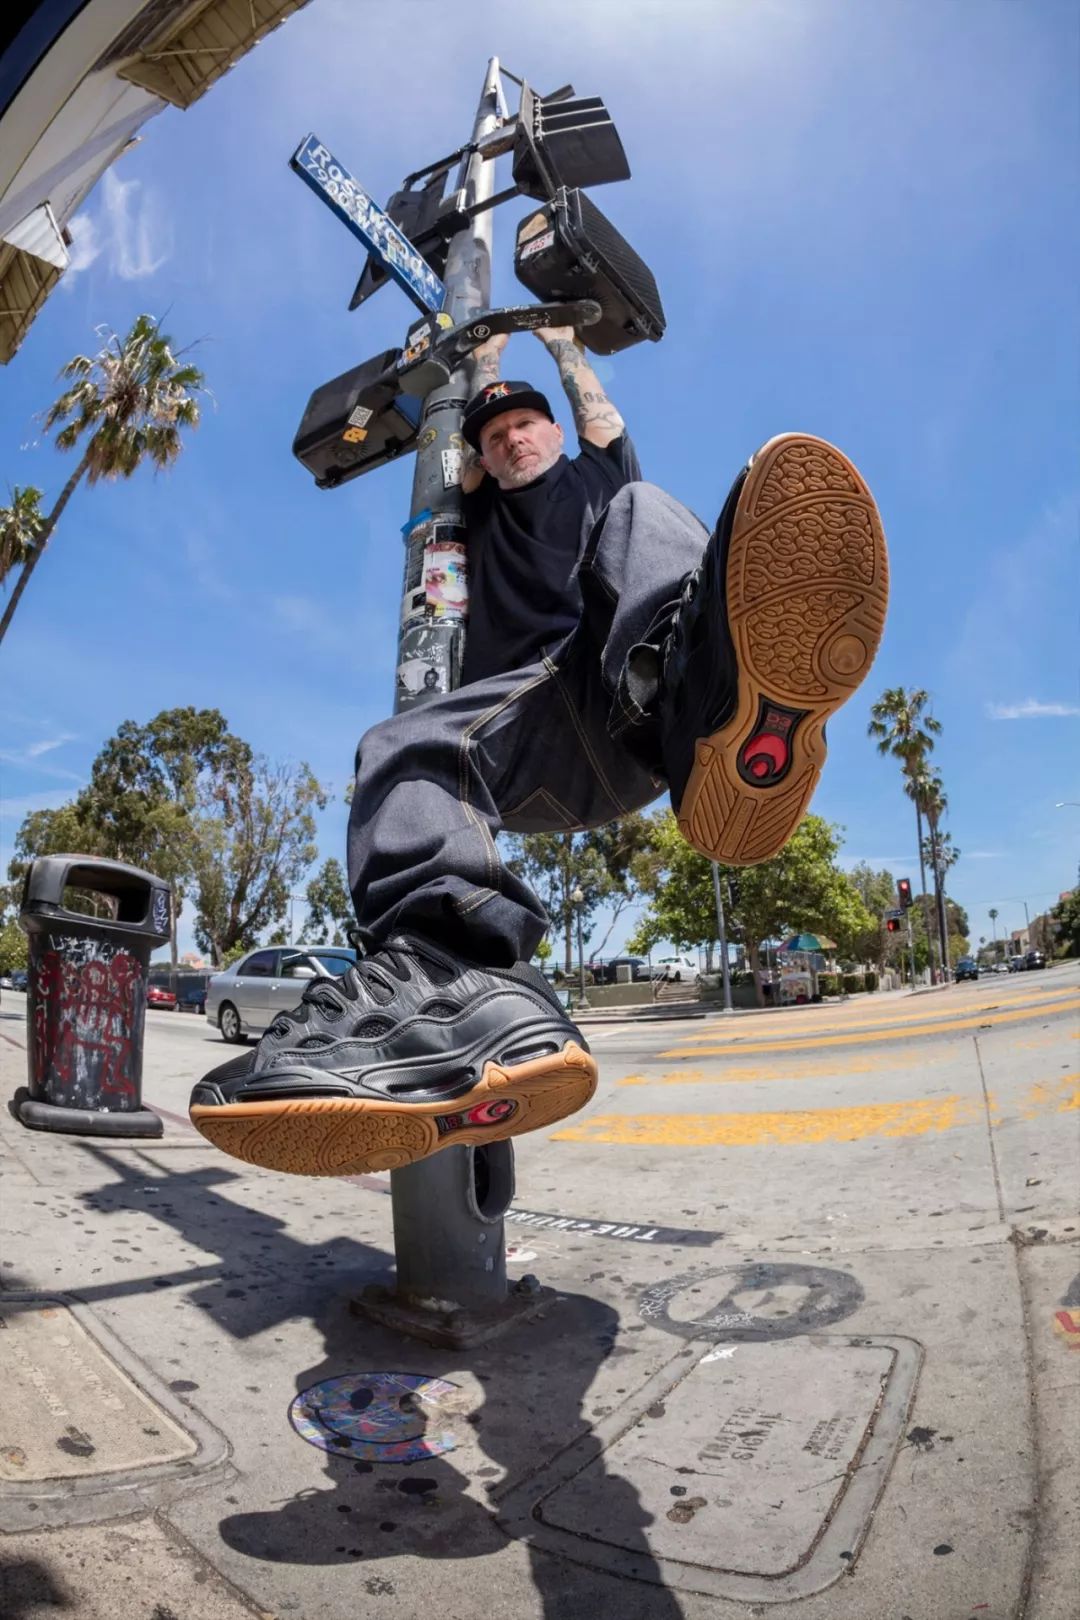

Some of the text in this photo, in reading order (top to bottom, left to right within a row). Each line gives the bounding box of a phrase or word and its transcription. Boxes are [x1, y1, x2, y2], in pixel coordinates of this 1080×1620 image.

[310, 144, 425, 276] Rosewood
[597, 1224, 658, 1240] THE
[697, 1406, 756, 1461] TRAFFIC
[731, 1411, 783, 1461] SIGNAL
